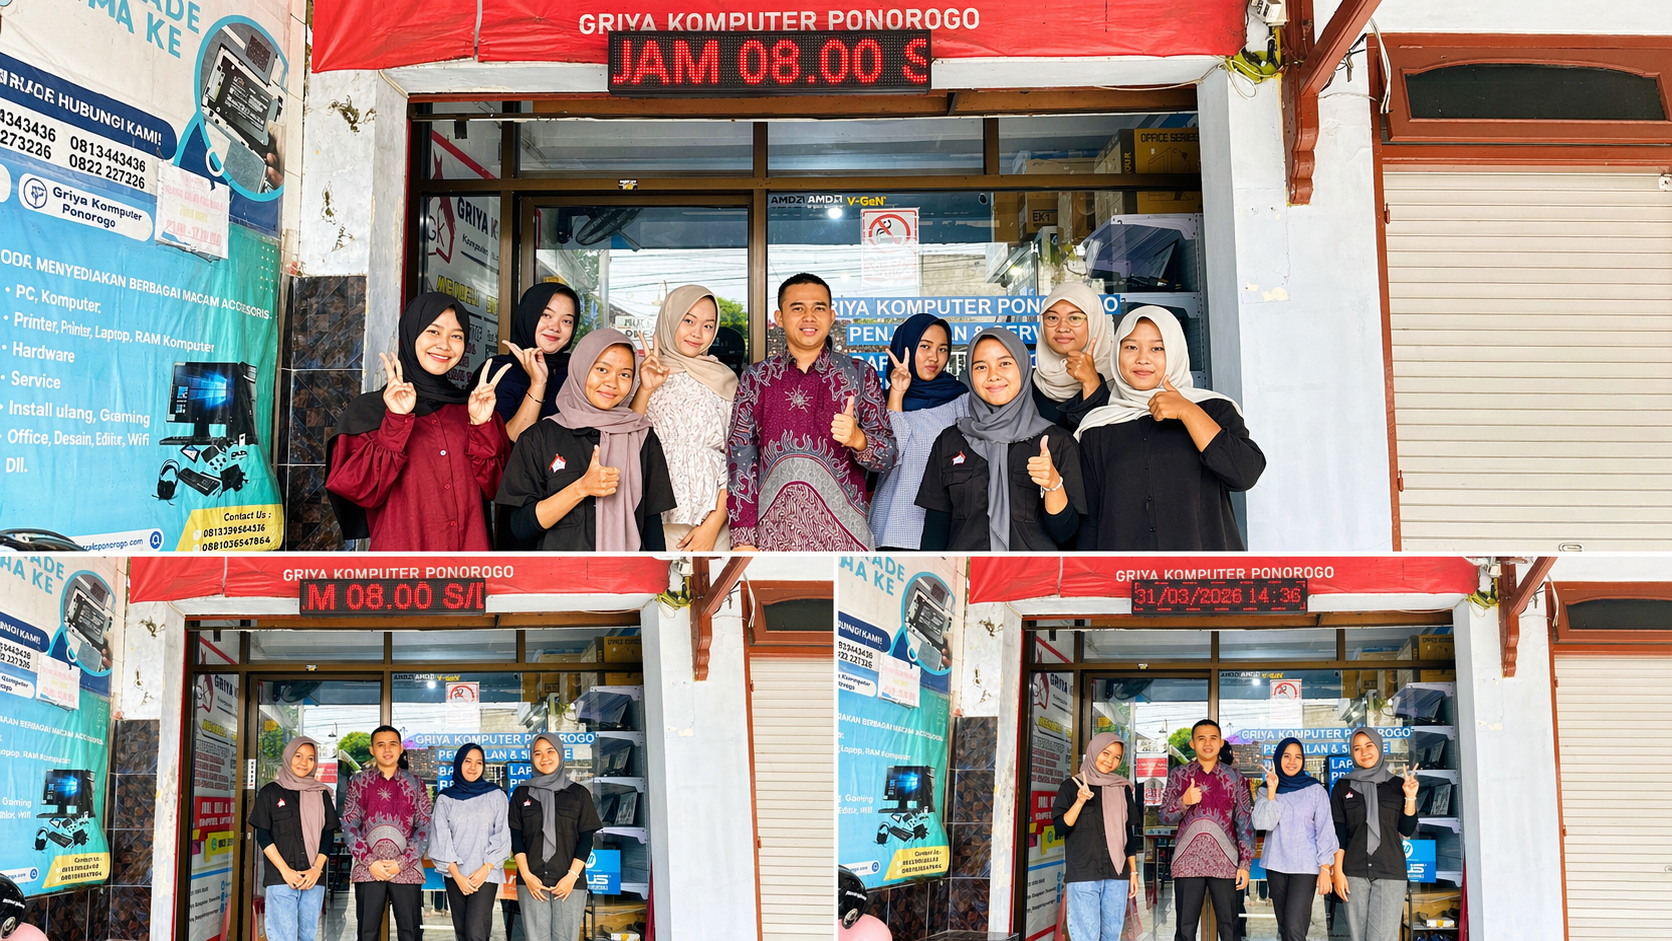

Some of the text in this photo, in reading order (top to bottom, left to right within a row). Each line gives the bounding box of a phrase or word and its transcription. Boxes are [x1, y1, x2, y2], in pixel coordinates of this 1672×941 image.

[578, 7, 980, 35] GRIYA KOMPUTER PONOROGO
[146, 12, 181, 59] KE
[611, 37, 928, 86] JAM 08.00 S
[58, 92, 124, 131] HUBUNGI
[126, 120, 162, 146] KAMI!
[69, 153, 102, 176] 0822
[52, 186, 143, 221] Griya Komputer
[62, 203, 116, 229] Ponorogo
[457, 196, 488, 235] GRIYA
[36, 256, 127, 288] MENYEDIAKAN
[129, 277, 181, 299] BERBAGAI
[182, 289, 219, 307] MACAM
[831, 299, 870, 316] RIYA
[877, 298, 992, 316] KOMPUTER
[14, 311, 59, 335] Printer,
[135, 330, 161, 345] RAM
[163, 334, 215, 353] Komputer
[12, 341, 75, 363] Hardware
[11, 370, 61, 389] Service
[9, 400, 53, 417] Install
[56, 403, 97, 424] ulang,
[7, 428, 52, 447] Office,
[54, 430, 94, 448] Desain,
[128, 432, 150, 446] Wifi
[6, 456, 28, 473] Dll.
[32, 568, 53, 595] KE
[283, 565, 514, 582] GRIYA KOMPUTER PONOROGO
[874, 569, 894, 596] KE
[1116, 566, 1335, 582] GRIYA KOMPUTER PONOROGO
[346, 581, 433, 610] 08.00
[1134, 587, 1243, 606] 31/03/2026
[454, 733, 521, 744] KOMPUTER
[1278, 728, 1342, 739] KOMPUTER
